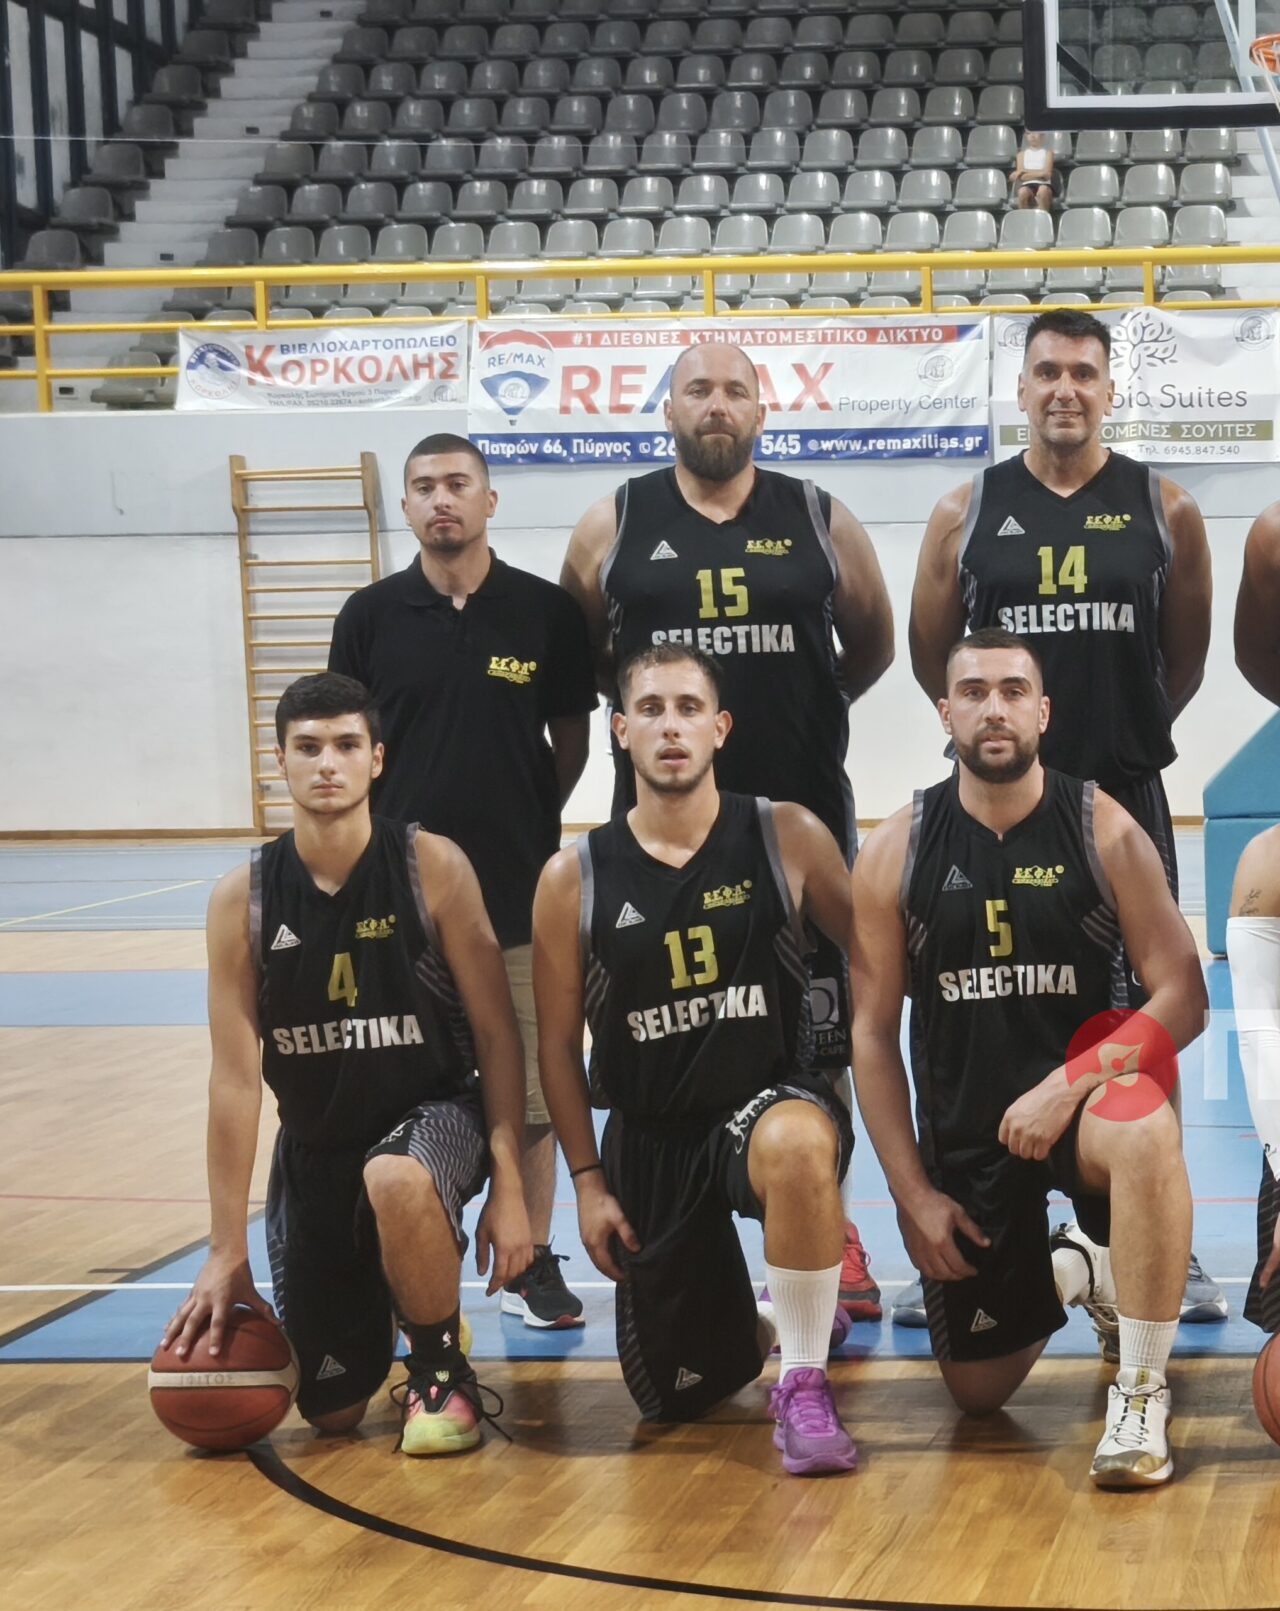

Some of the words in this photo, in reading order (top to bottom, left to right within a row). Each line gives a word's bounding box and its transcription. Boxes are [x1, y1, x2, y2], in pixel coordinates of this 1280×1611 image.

[280, 334, 457, 355] ΒΙΒΛΙΟΧΑΡΤΟΠΩΛΕΙΟ
[573, 332, 593, 346] #1
[600, 330, 681, 346] ΔΙΕΘΝΕΣ
[690, 329, 868, 345] ΚΤΗΜΑΤΟΜΕΣΙΤΙΚΟ
[876, 327, 943, 343] ΔΙΚΤΥΟ
[244, 344, 460, 387] ΚΟΡΚΟΛΗΣ
[487, 352, 546, 368] RE/MAX
[559, 362, 836, 415] RE/AX
[838, 396, 912, 415] Property
[918, 395, 977, 411] Center
[1160, 384, 1248, 409] Suites
[477, 439, 539, 458] Πατρών
[572, 438, 632, 458] Πύργος
[820, 434, 984, 452] www.remaxilias.gr
[1181, 423, 1257, 438] ΣΟΥΙΤΕΣ
[1037, 545, 1088, 595] 14
[696, 567, 749, 619] 15
[997, 602, 1135, 635] SELECTIKA
[985, 899, 1013, 957] 5
[664, 925, 719, 990] 13
[327, 951, 358, 1007] 4
[938, 964, 1078, 1002] SELECTIKA
[272, 1014, 425, 1055] SELECTIKA
